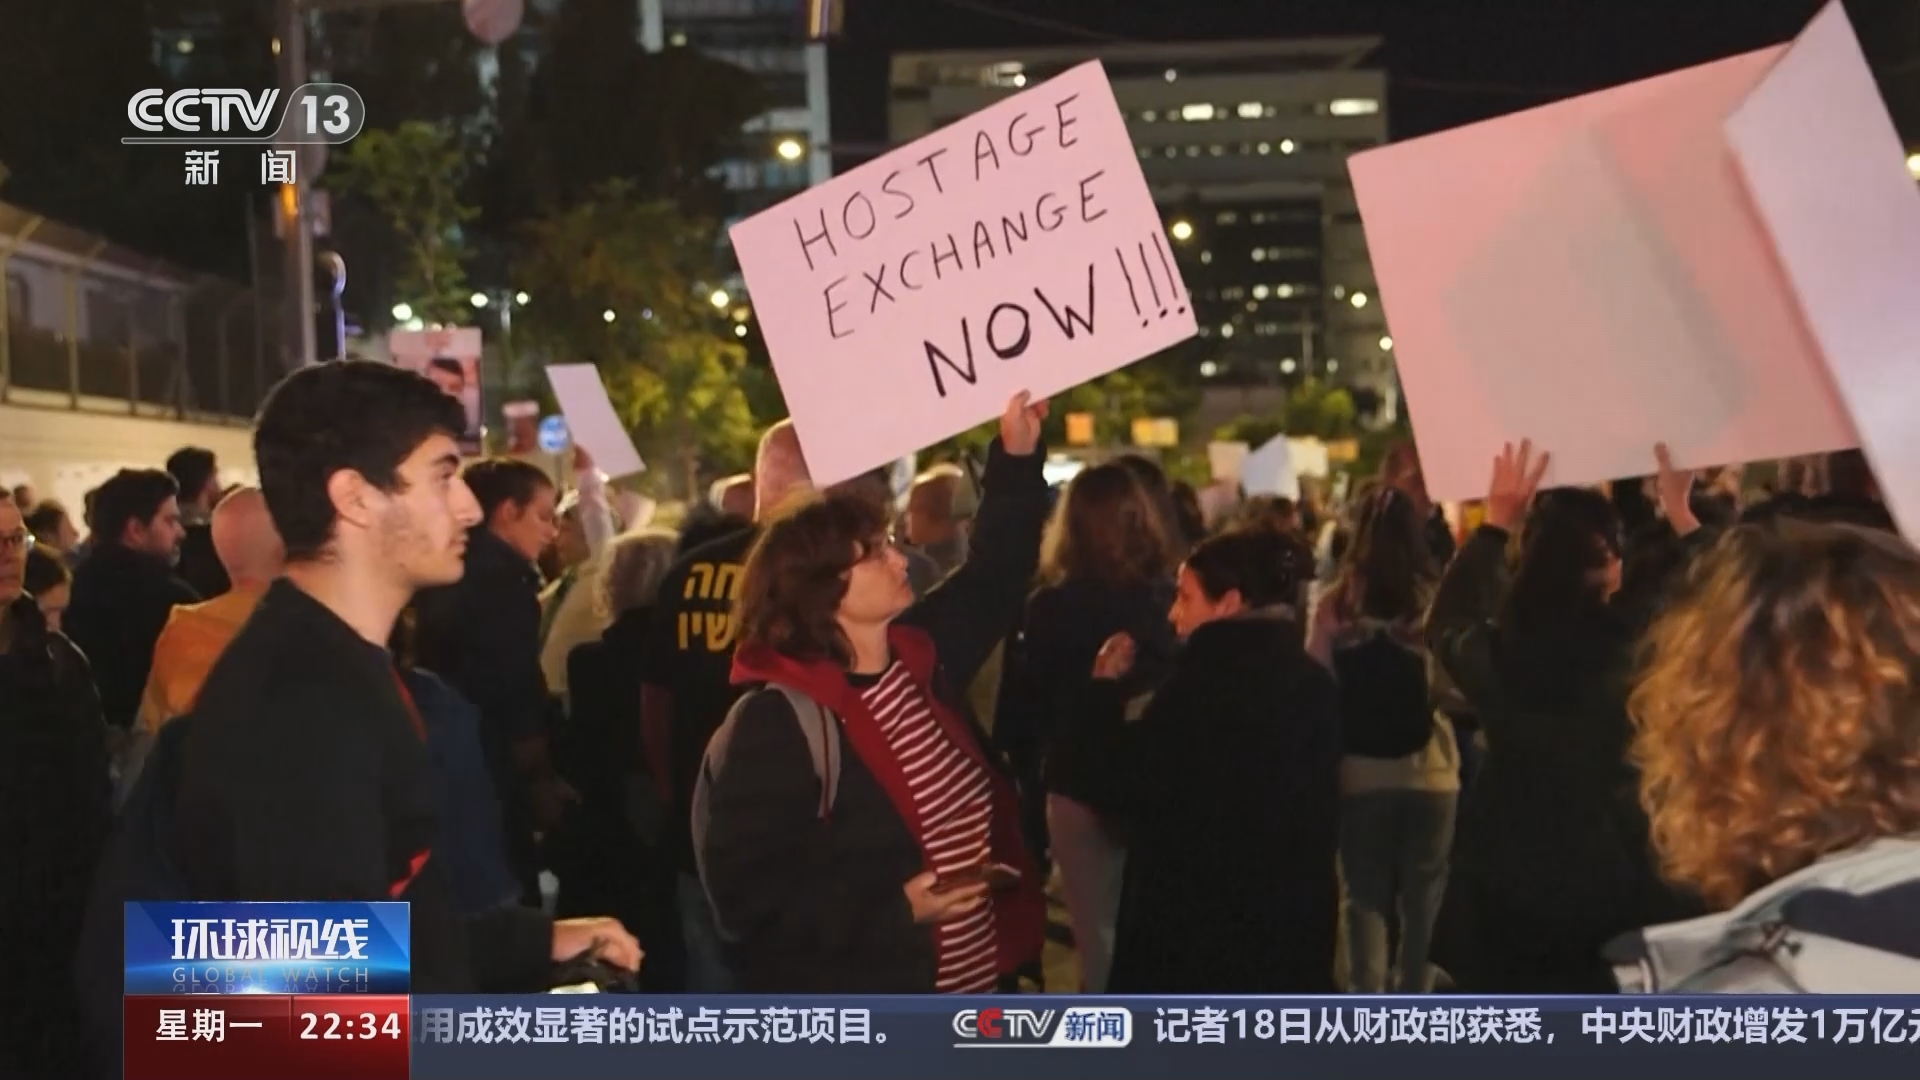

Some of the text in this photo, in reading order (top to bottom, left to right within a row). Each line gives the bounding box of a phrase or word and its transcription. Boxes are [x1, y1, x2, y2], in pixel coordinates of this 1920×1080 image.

[793, 92, 1080, 271] HOSTAGE
[823, 169, 1108, 339] EXCHANGE
[678, 611, 737, 651] שיו
[683, 562, 742, 600] חה
